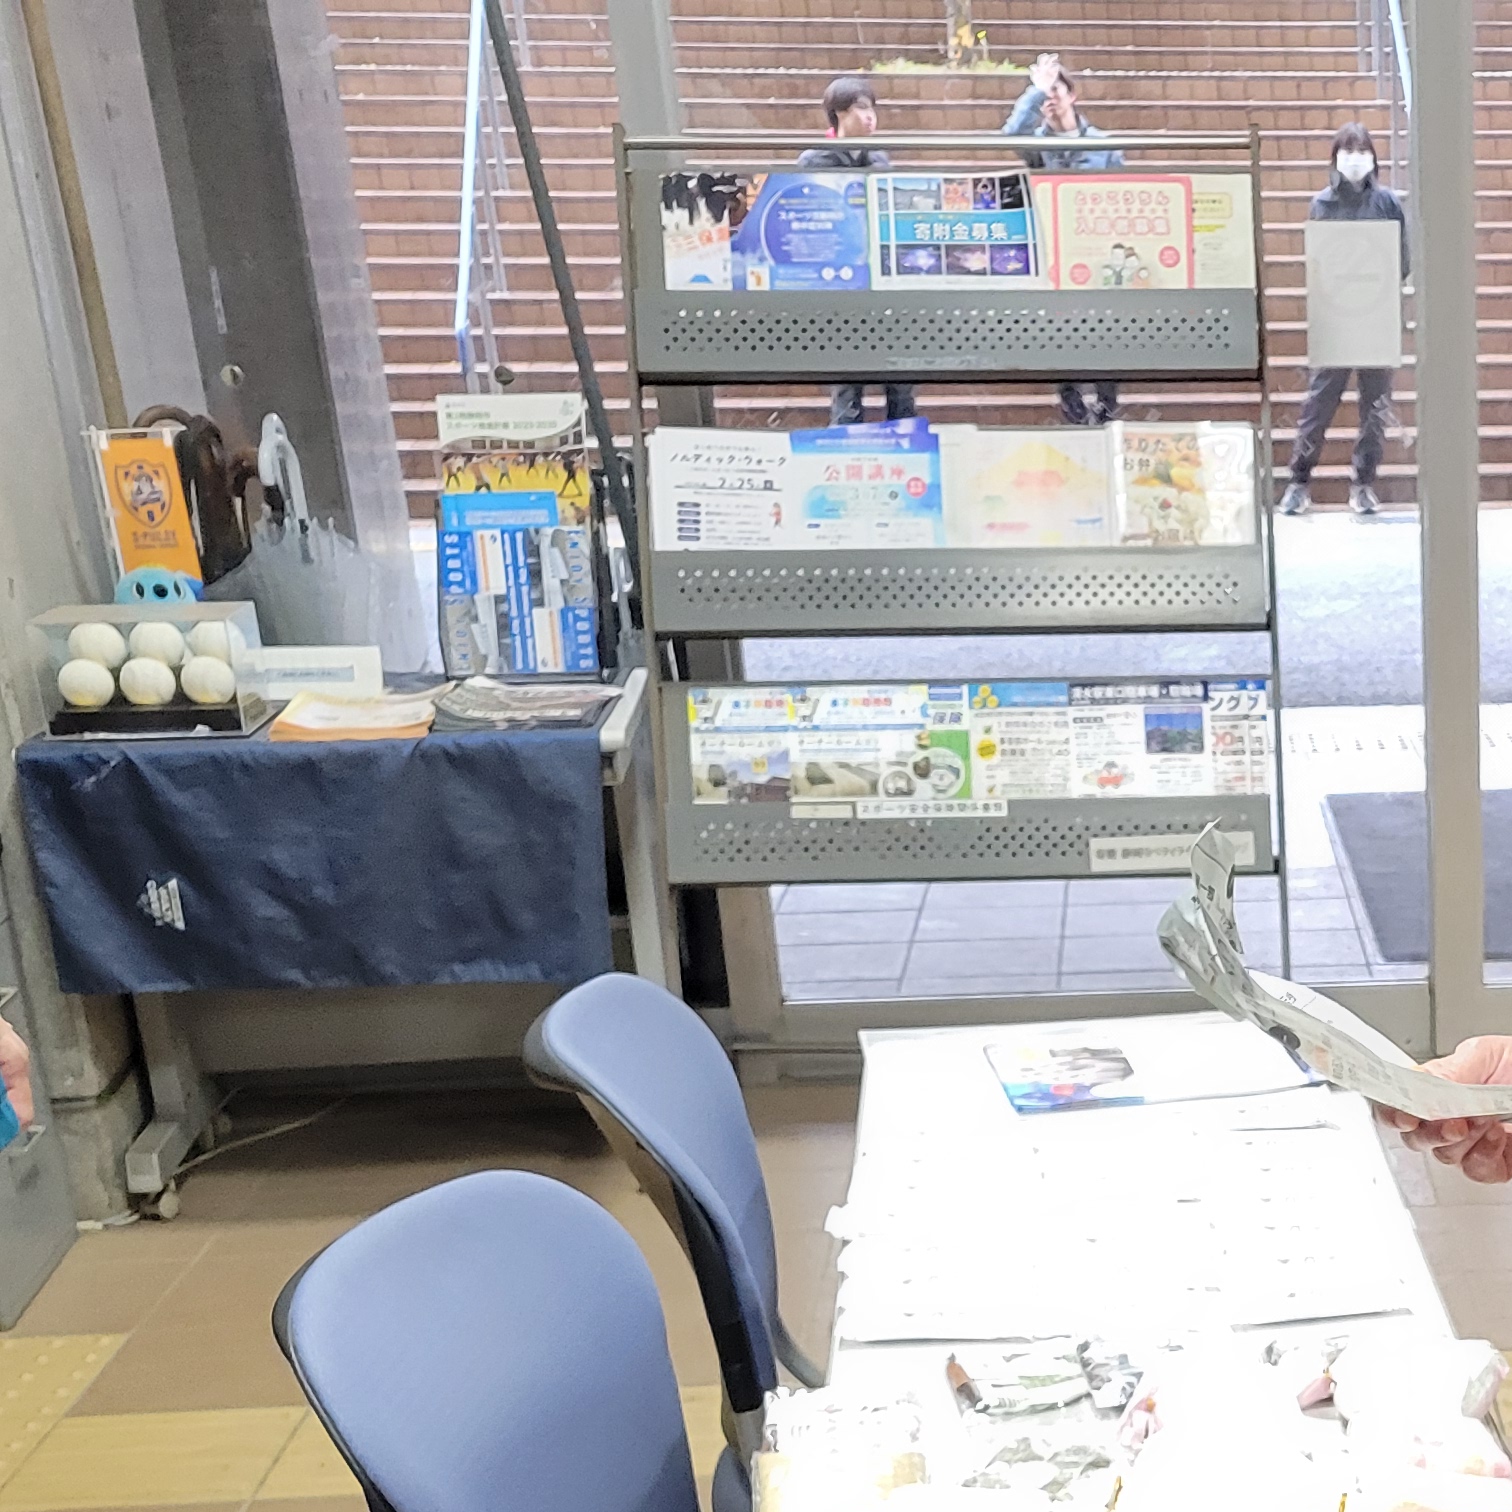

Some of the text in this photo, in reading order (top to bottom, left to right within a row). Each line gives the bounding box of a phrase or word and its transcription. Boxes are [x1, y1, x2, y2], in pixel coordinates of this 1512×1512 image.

[913, 221, 1009, 241] 寄附金募集
